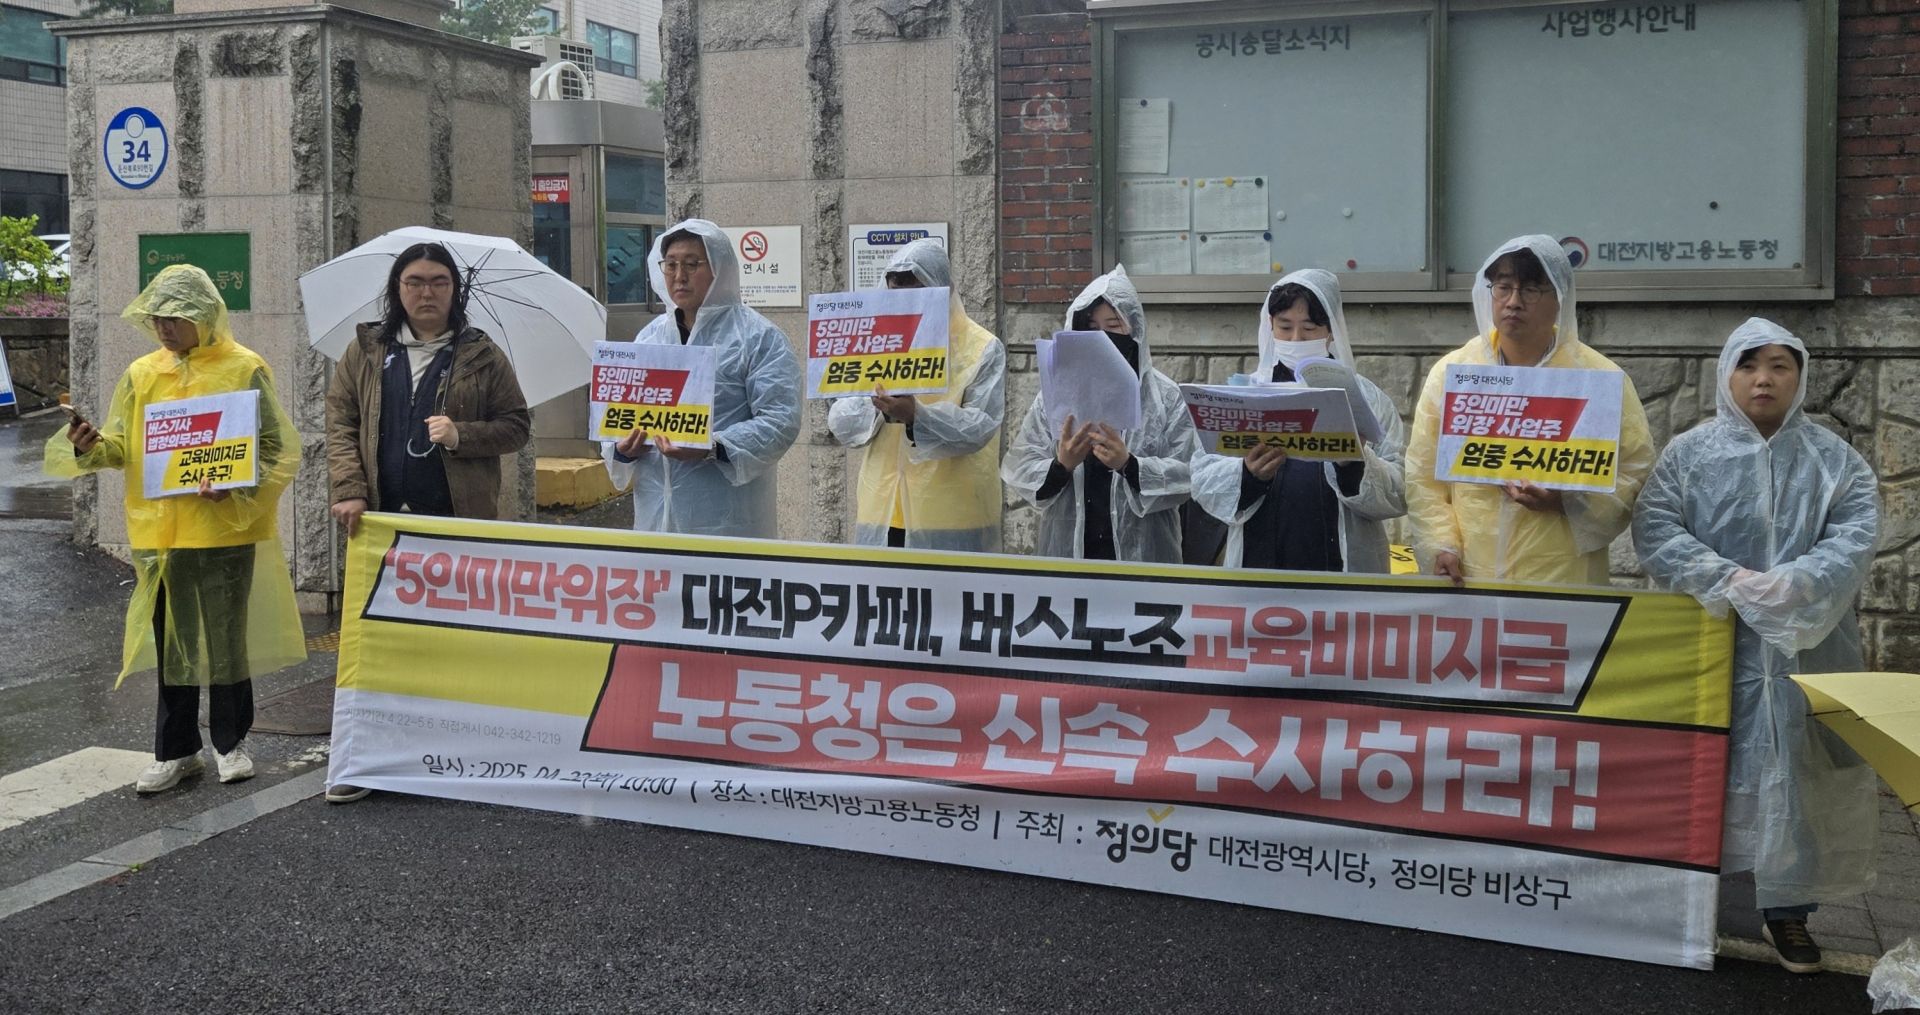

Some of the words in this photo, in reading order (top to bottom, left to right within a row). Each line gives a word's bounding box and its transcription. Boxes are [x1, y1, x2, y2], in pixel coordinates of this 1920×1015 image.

[1541, 3, 1696, 38] 사업행사안내
[1195, 24, 1350, 59] 공시송달소식지
[122, 140, 151, 163] 34
[871, 233, 892, 242] CCTV
[893, 232, 908, 243] 설치
[1598, 239, 1779, 261] 대전지방고용노동청
[743, 263, 779, 275] 연시설
[816, 302, 836, 312] 정의당
[837, 300, 863, 309] 대전시당
[816, 317, 876, 338] 5인미만
[816, 336, 851, 356] 위장
[852, 333, 903, 353] 사업주
[597, 367, 648, 385] 5인미만
[827, 361, 862, 384] 엄중
[865, 357, 946, 382] 수사하라!
[1455, 374, 1480, 385] 정의당
[1482, 375, 1514, 385] 대전시당
[597, 384, 626, 402] 위장
[628, 386, 673, 405] 사업주
[1452, 394, 1530, 416] 5인미만
[605, 407, 635, 430] 엄중
[638, 410, 709, 435] 수사하라!
[1197, 405, 1265, 420] 5인미만
[147, 417, 192, 436] 버스기사
[1202, 418, 1240, 432] 위장
[1245, 421, 1303, 434] 사업주
[1451, 414, 1495, 436] 위장
[1497, 418, 1563, 439] 사업주
[147, 429, 214, 451] 법정의무교육
[1265, 436, 1356, 453] 수사하라!
[179, 443, 247, 467] 교육비미지급
[1461, 442, 1507, 469] 엄중
[1510, 446, 1615, 476] 수사하라!
[179, 467, 204, 485] 수사
[206, 464, 233, 482] 촉구!
[682, 573, 942, 657] 대전P카페,
[483, 725, 561, 745] 042-342-1219
[652, 662, 962, 768] 노동청은
[981, 693, 1150, 786] 신속
[1163, 708, 1600, 831] 수사하라!
[771, 787, 981, 831] 대전지방고용노동청
[1095, 819, 1198, 872] 정의당
[1208, 835, 1376, 889] 대전광역시당,
[1390, 858, 1476, 898] 정의당
[1484, 872, 1572, 910] 비상구
